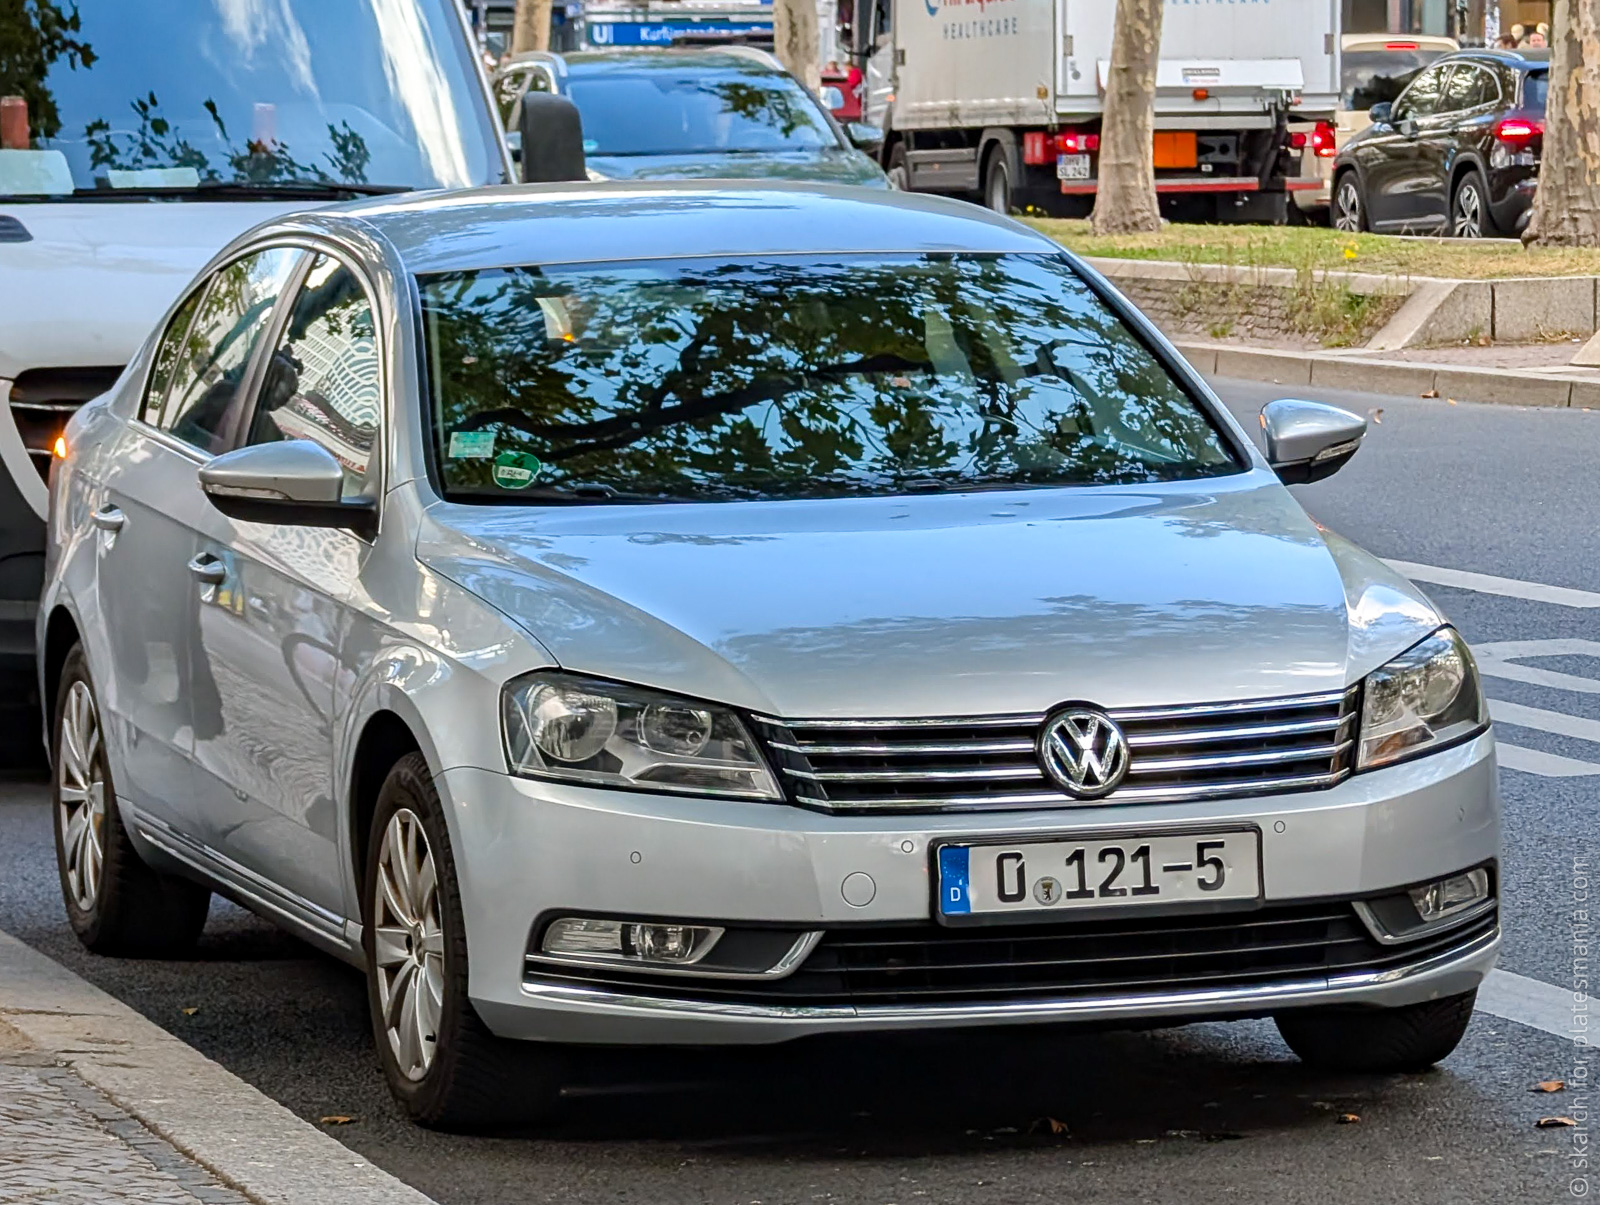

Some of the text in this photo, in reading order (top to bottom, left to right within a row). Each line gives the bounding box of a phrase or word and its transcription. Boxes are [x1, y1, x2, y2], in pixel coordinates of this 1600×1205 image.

[942, 17, 1018, 40] HEALTHCARE
[1065, 839, 1226, 899] 121-5
[950, 887, 961, 902] D
